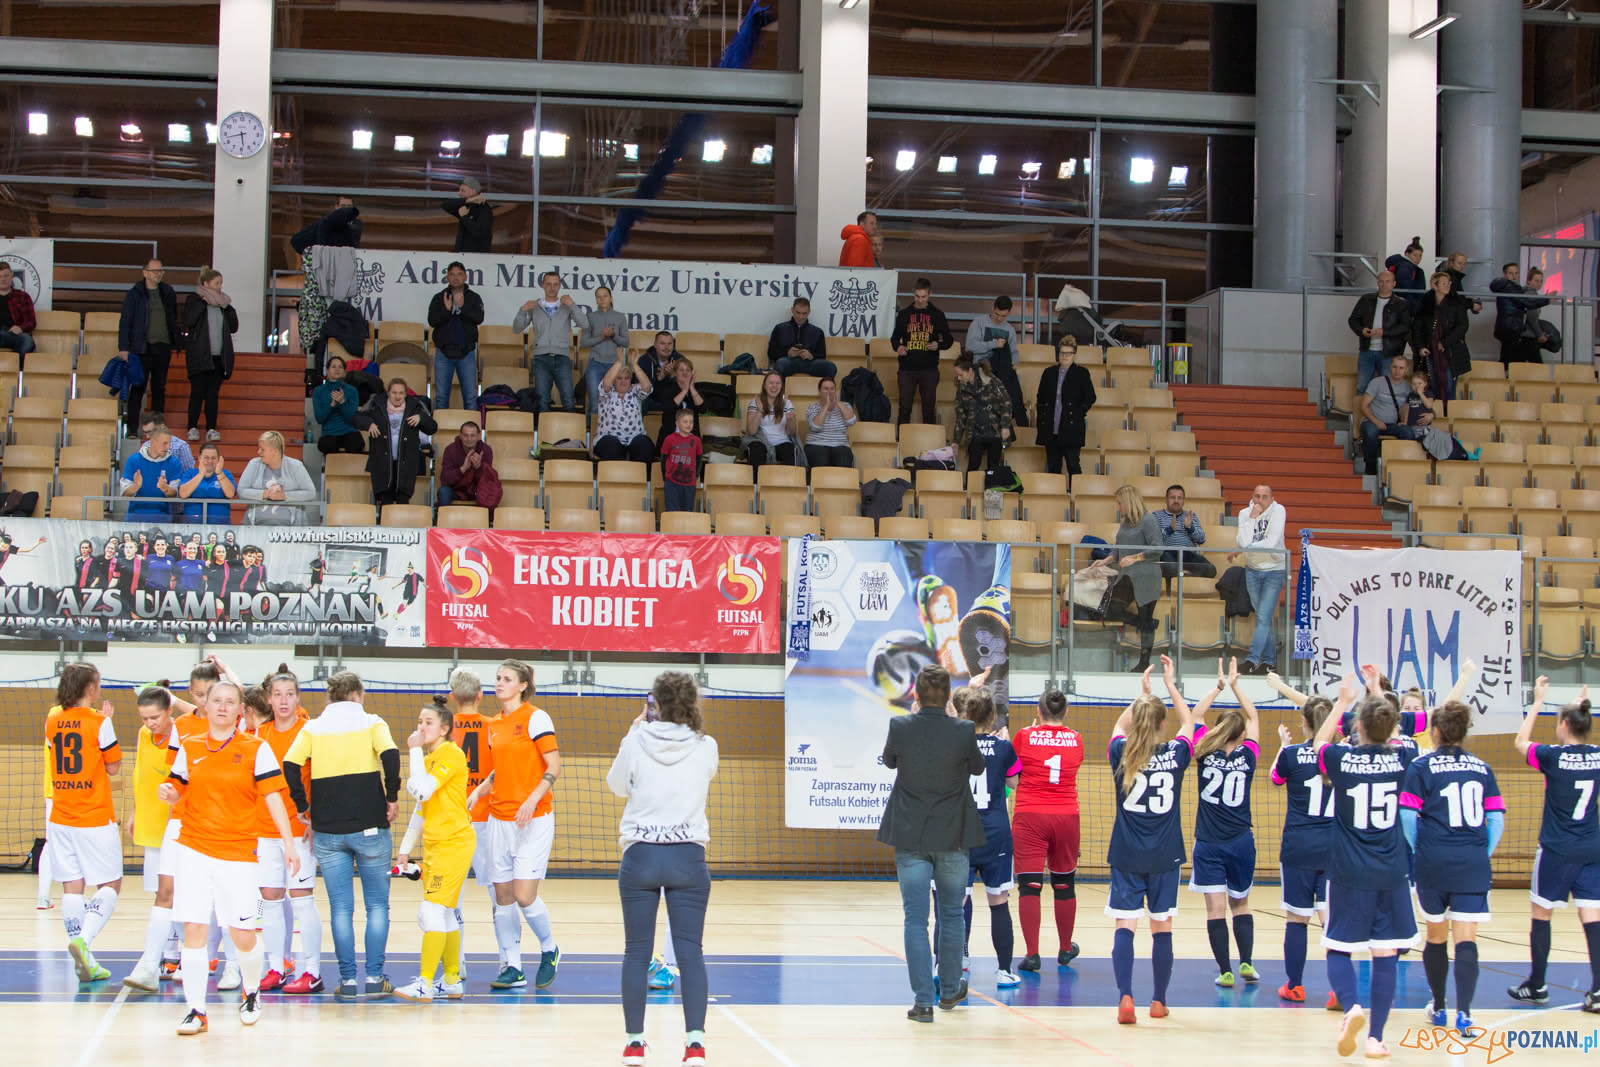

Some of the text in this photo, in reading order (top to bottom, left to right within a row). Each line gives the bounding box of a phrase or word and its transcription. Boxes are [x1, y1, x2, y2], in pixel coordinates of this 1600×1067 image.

[669, 269, 819, 300] University
[268, 530, 420, 546] www.futsalistki-uam.pl
[513, 555, 697, 589] EKSTRALIGA
[56, 587, 122, 616] AZS
[135, 589, 217, 620] UAM
[229, 583, 375, 621] POZNAŃ
[796, 570, 808, 616] FUTSAL
[1326, 570, 1498, 620] DLA WAS TO PARE LITER
[441, 603, 489, 618] FUTSAL
[552, 595, 659, 627] KOBIET
[717, 609, 764, 624] FUTSAL
[80, 618, 101, 631] NA
[107, 619, 157, 632] MECZE
[162, 620, 247, 634] EKSTRALIGI
[252, 622, 316, 636] FUTSALU
[320, 622, 375, 637] KOBIET
[1352, 605, 1460, 689] UAM
[1323, 647, 1342, 686] DLA
[1466, 655, 1503, 715] ŻYCIE
[1029, 738, 1078, 747] WARSZAWA
[1055, 731, 1076, 739] AWF
[53, 732, 82, 774] 13
[1340, 762, 1405, 774] WARSZAWA
[1342, 753, 1370, 764] AZS
[1429, 755, 1455, 765] AZS
[1558, 752, 1583, 761] AZS
[1044, 755, 1061, 784] 1
[1429, 763, 1488, 775] WARSZAWA
[811, 779, 893, 793] Zapraszamy na
[1123, 771, 1174, 814] 23
[1201, 767, 1246, 807] 20
[1574, 780, 1594, 820] 7
[809, 796, 846, 807] Futsalu
[848, 796, 880, 808] Kobiet
[1347, 781, 1398, 830] 15
[1440, 781, 1484, 828] 10
